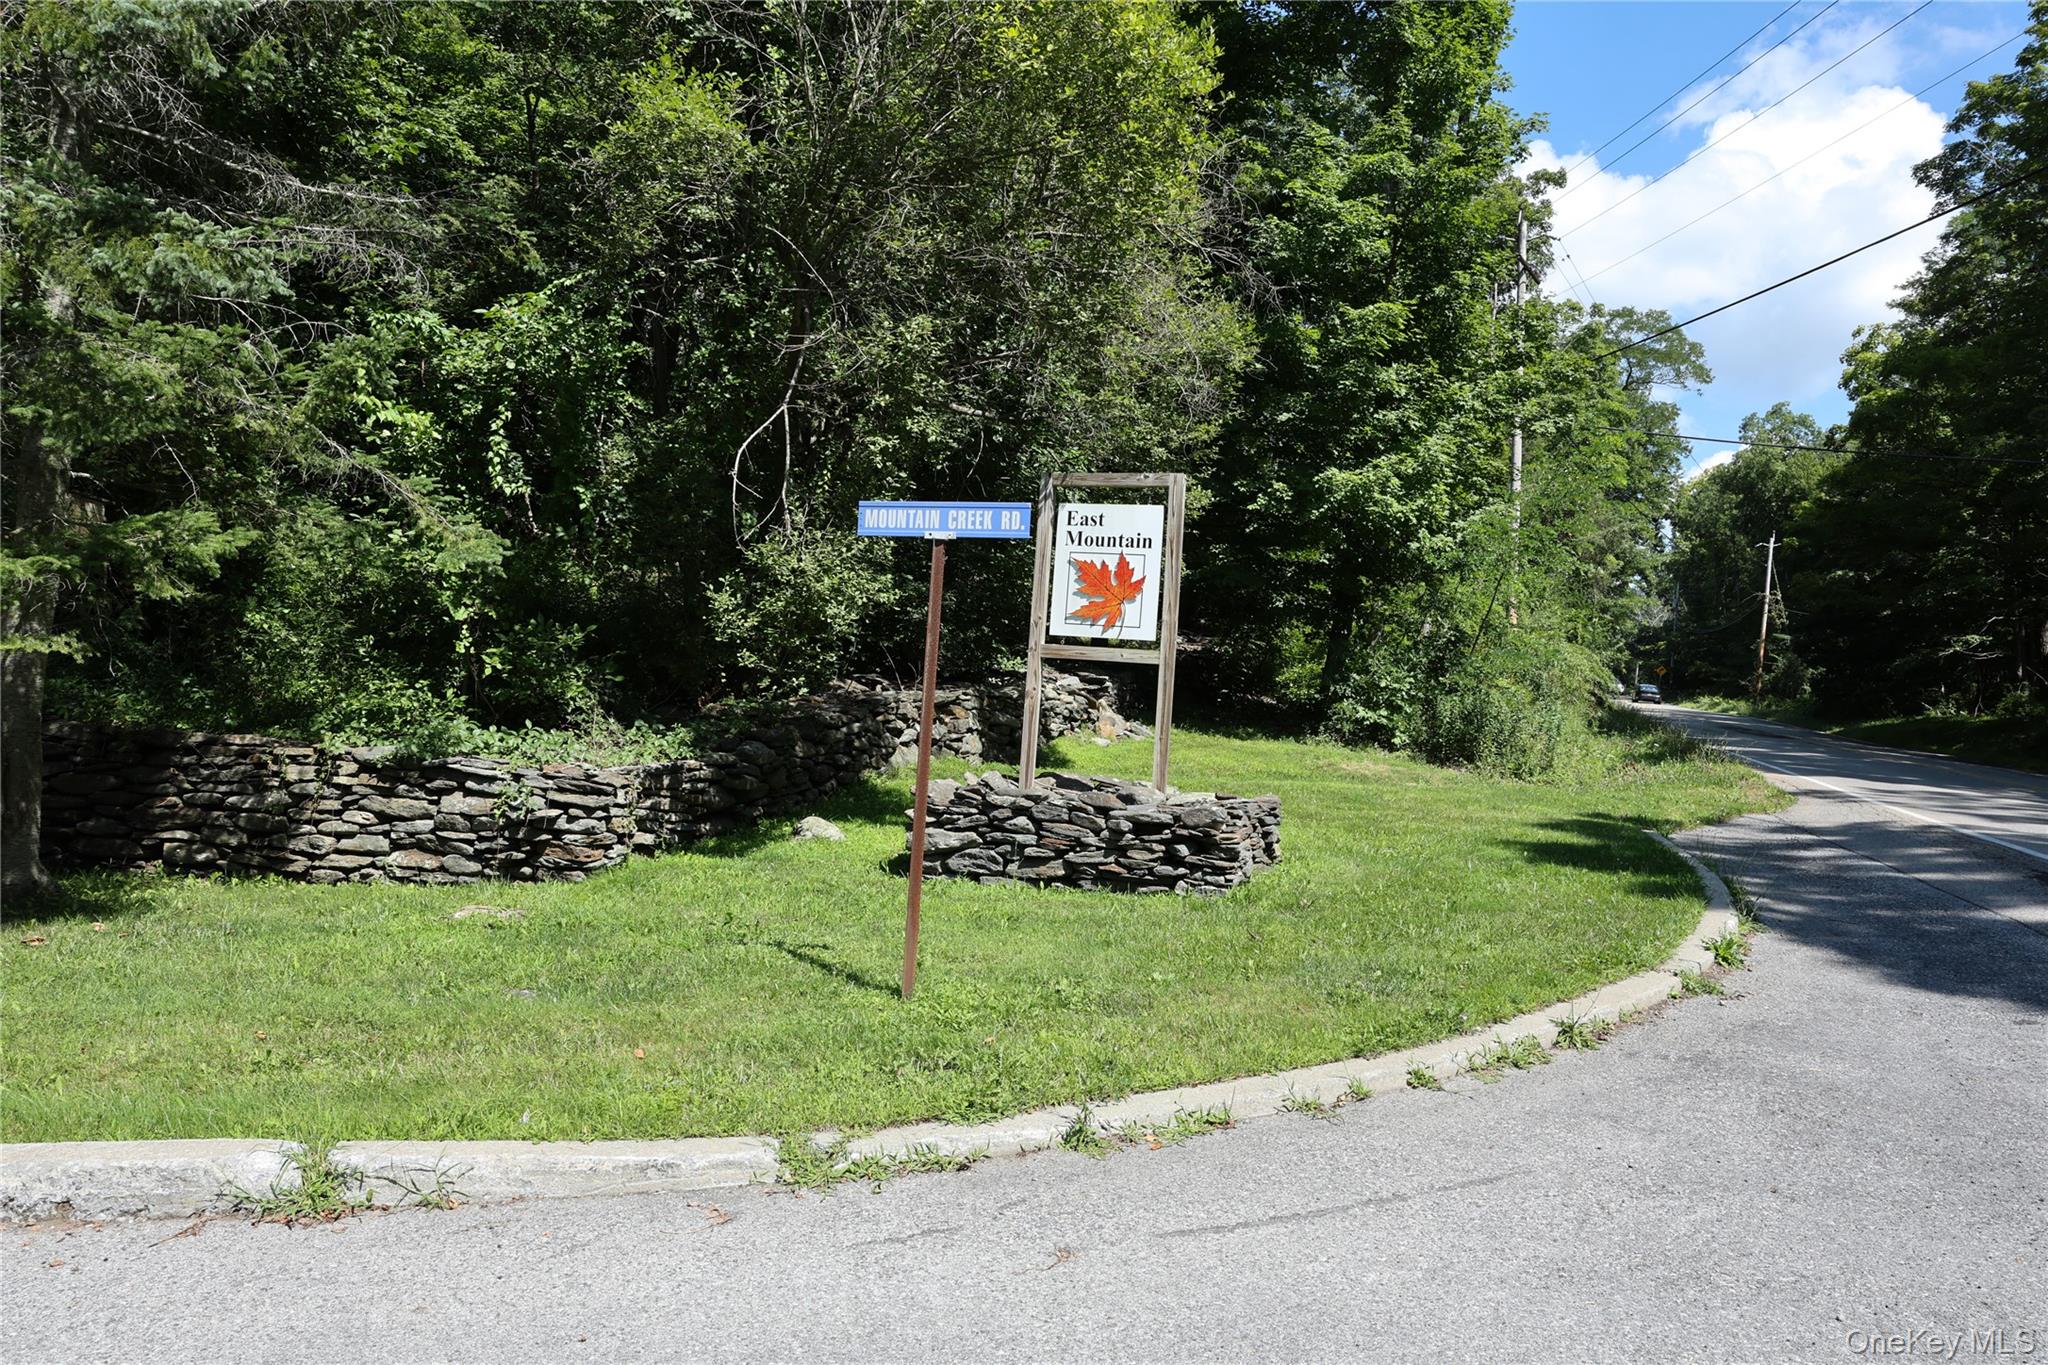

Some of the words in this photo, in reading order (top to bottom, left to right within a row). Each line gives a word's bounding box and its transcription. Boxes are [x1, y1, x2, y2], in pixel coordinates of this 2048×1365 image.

[864, 508, 940, 529] MOUNTAIN
[947, 509, 993, 530] CREEK
[1001, 510, 1025, 531] RD.
[1066, 510, 1105, 527] East
[1065, 530, 1153, 549] Mountain
